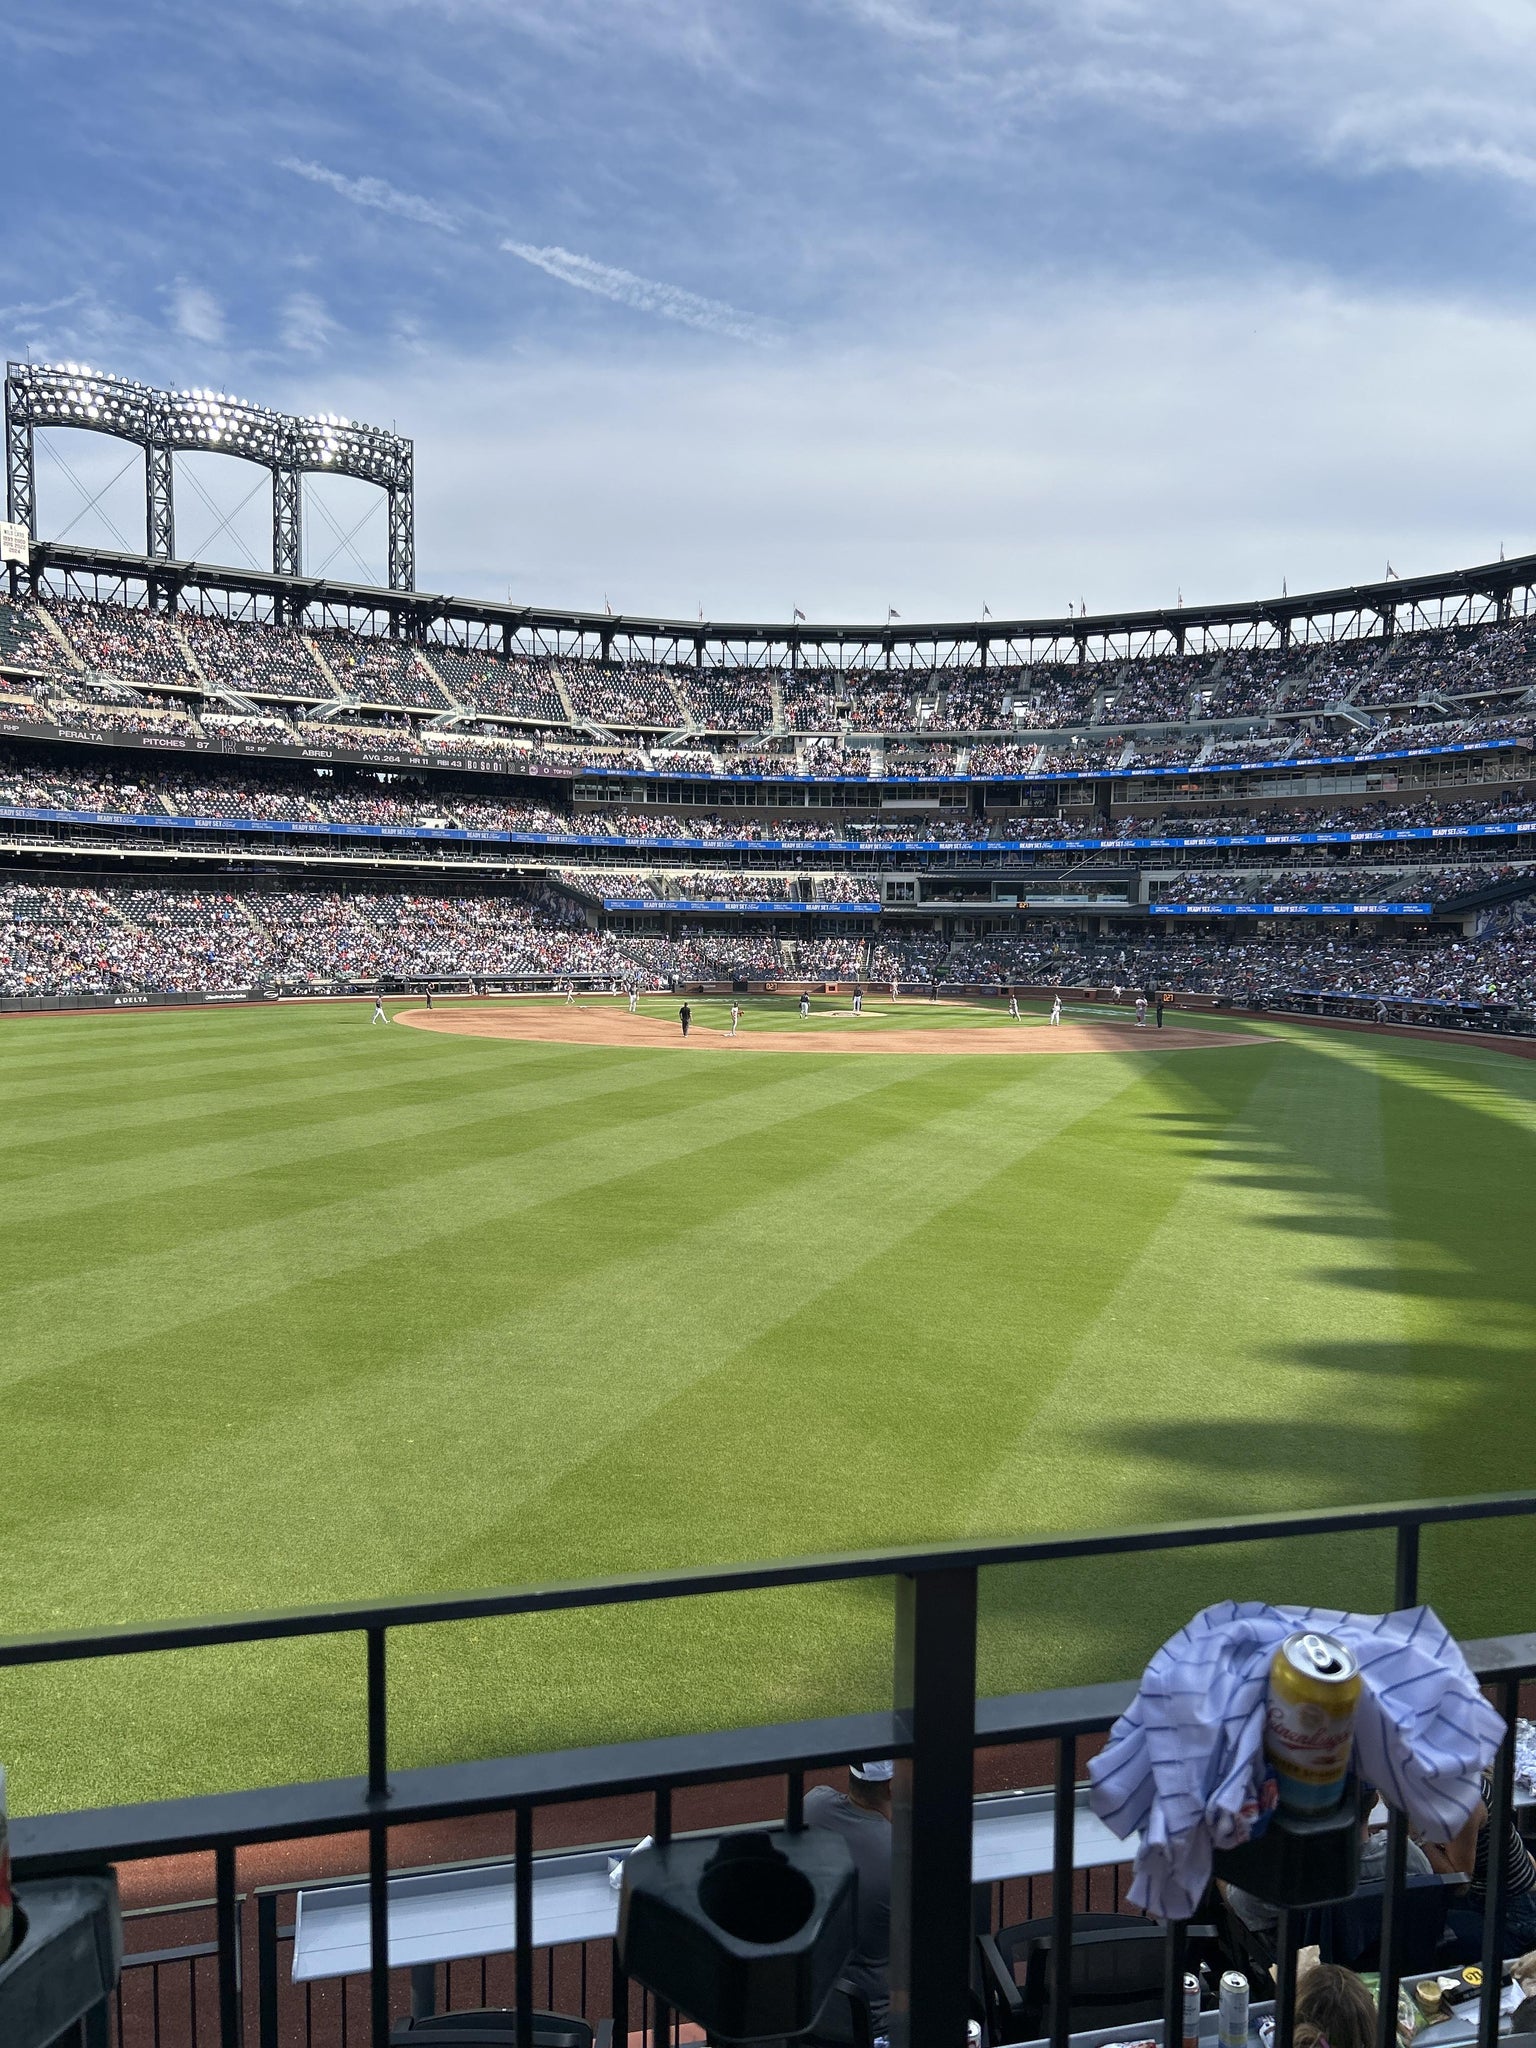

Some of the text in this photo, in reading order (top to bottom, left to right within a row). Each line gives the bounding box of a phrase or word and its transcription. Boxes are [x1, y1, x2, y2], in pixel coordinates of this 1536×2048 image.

[59, 730, 103, 741] PERALTA
[143, 738, 186, 747] PITCHES
[302, 750, 332, 758] ABREU
